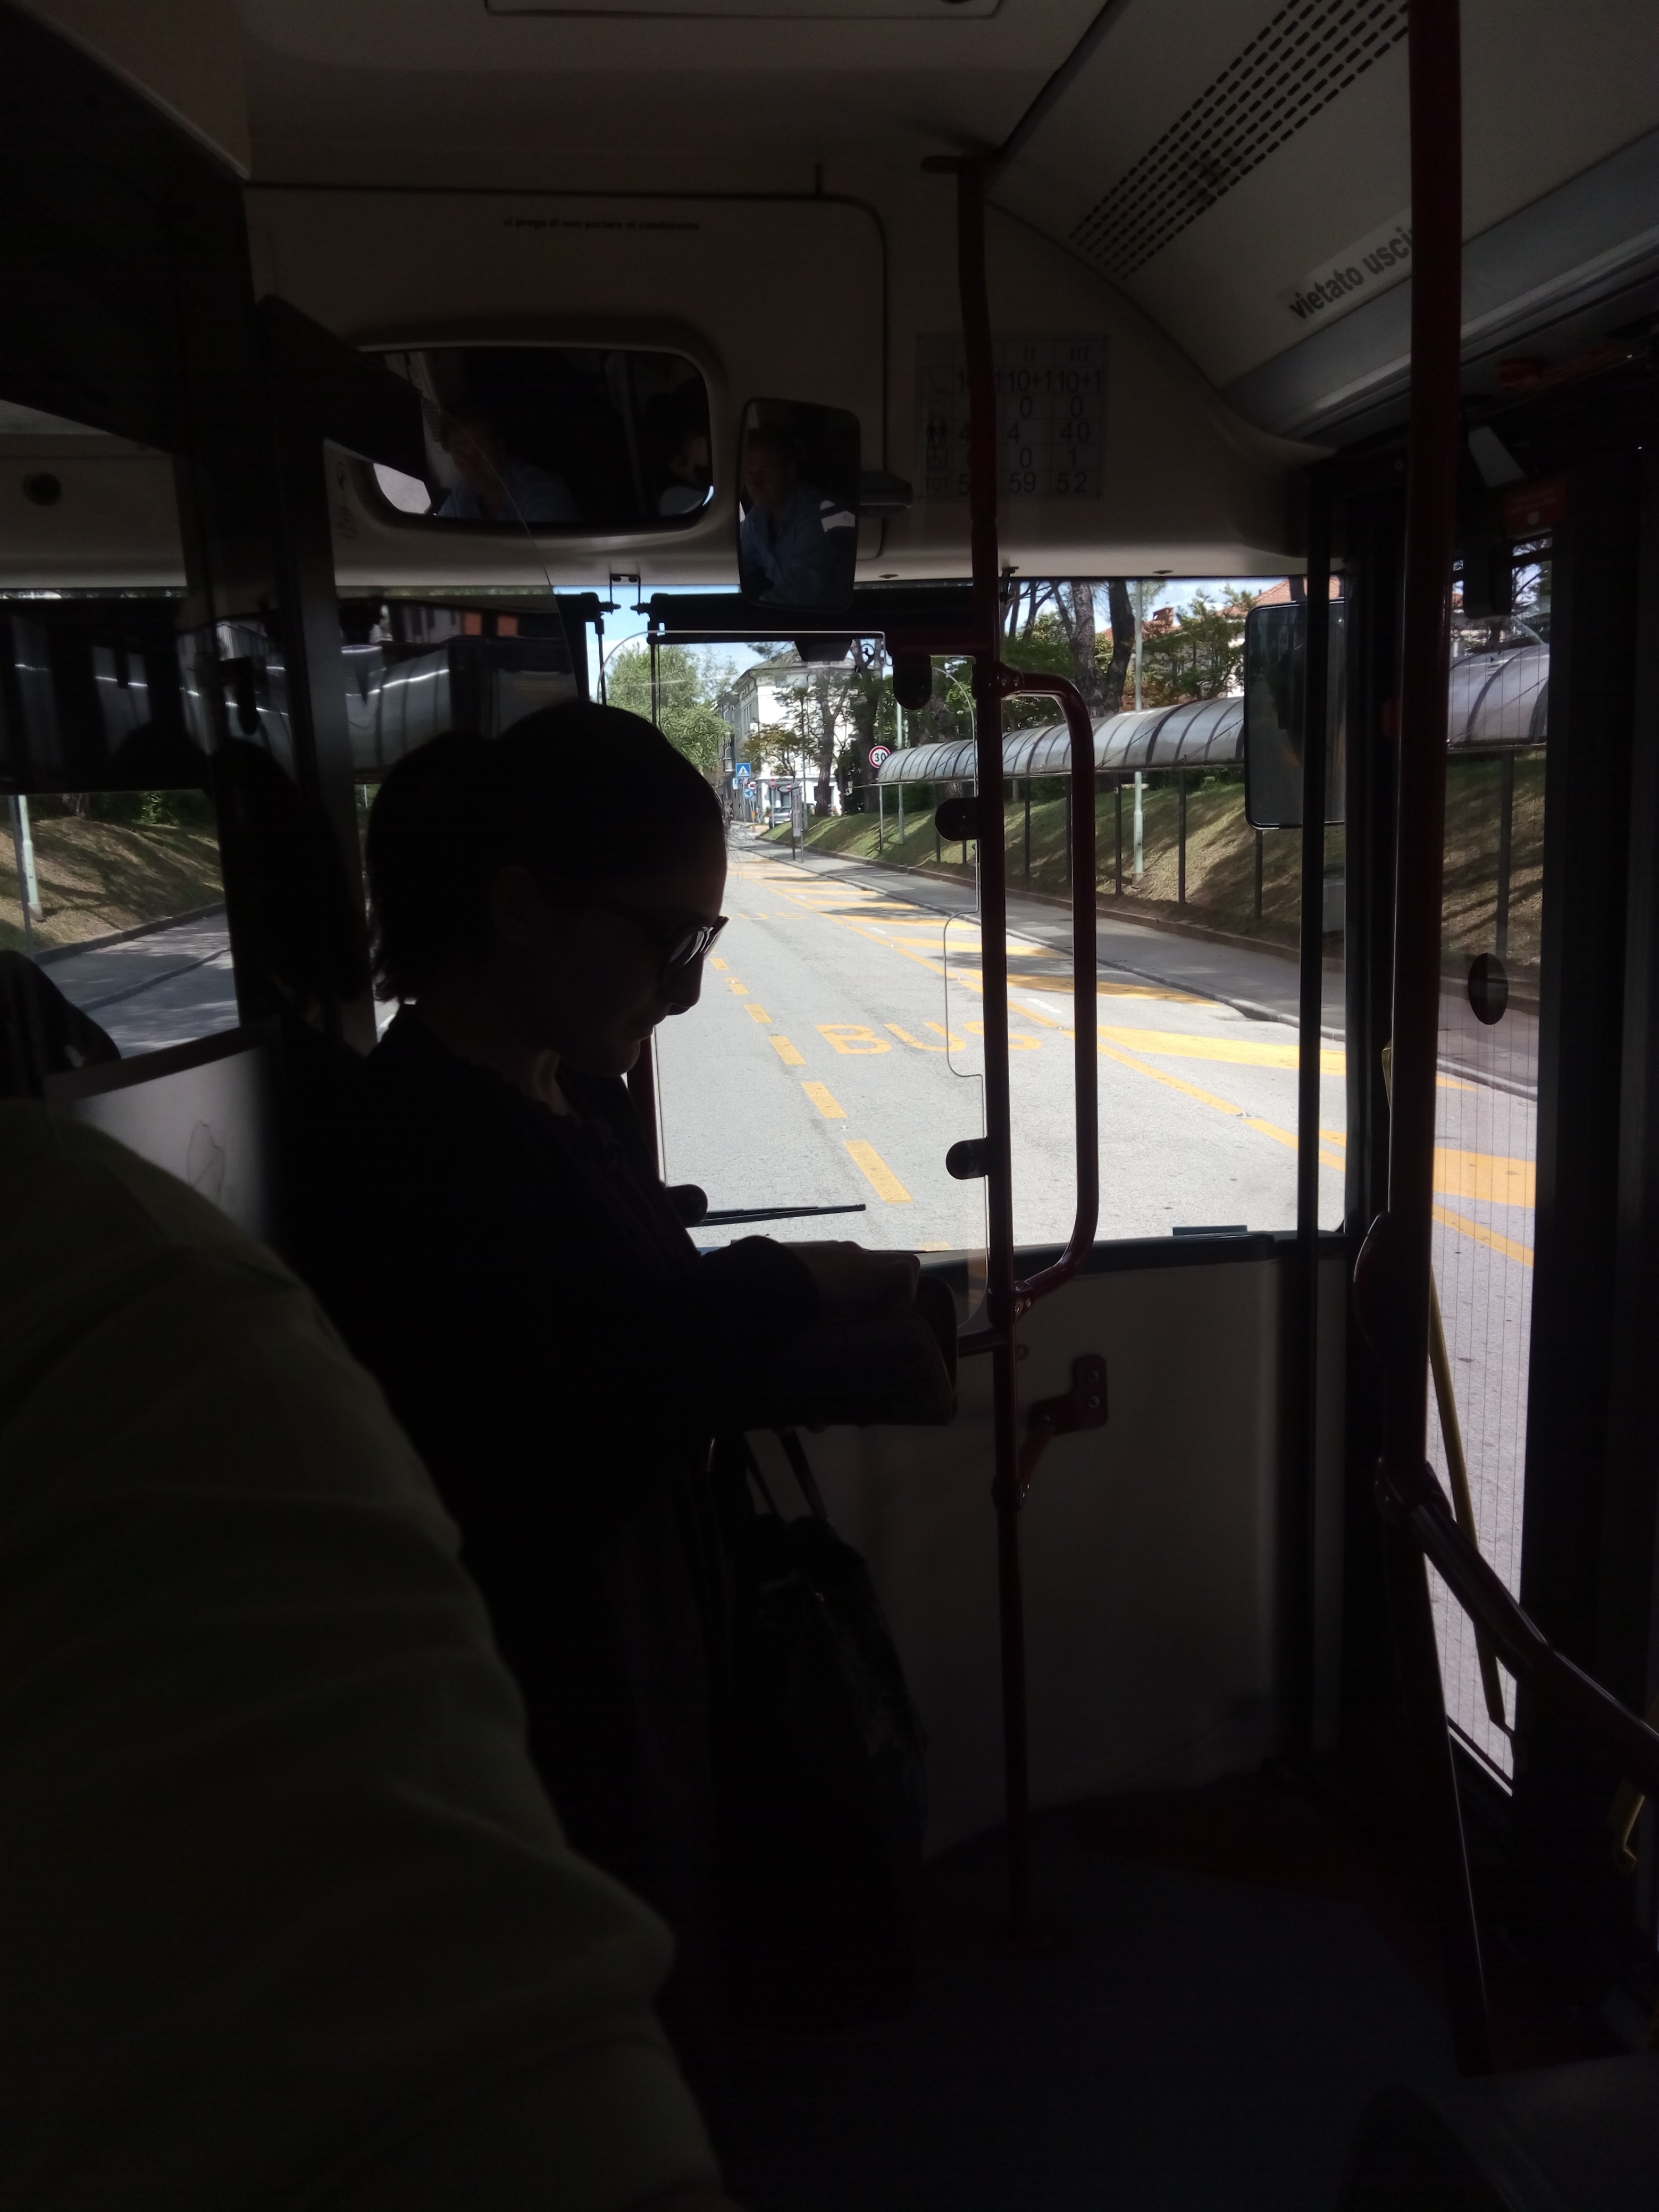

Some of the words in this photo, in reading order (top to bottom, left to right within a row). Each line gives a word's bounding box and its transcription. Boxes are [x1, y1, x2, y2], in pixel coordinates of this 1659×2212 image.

[516, 219, 547, 229] prega
[549, 219, 559, 228] di
[585, 220, 623, 229] parlare
[639, 221, 700, 230] conducente
[1288, 266, 1363, 319] vietato
[1361, 225, 1412, 275] usci
[1019, 396, 1033, 417] 0
[1070, 395, 1083, 417] 0
[1019, 447, 1033, 468] 0
[1068, 447, 1077, 468] 1
[924, 476, 952, 491] TOT
[1008, 472, 1036, 493] 59
[1057, 472, 1087, 493] 52
[875, 752, 886, 762] 30
[815, 1022, 1043, 1054] BUS
